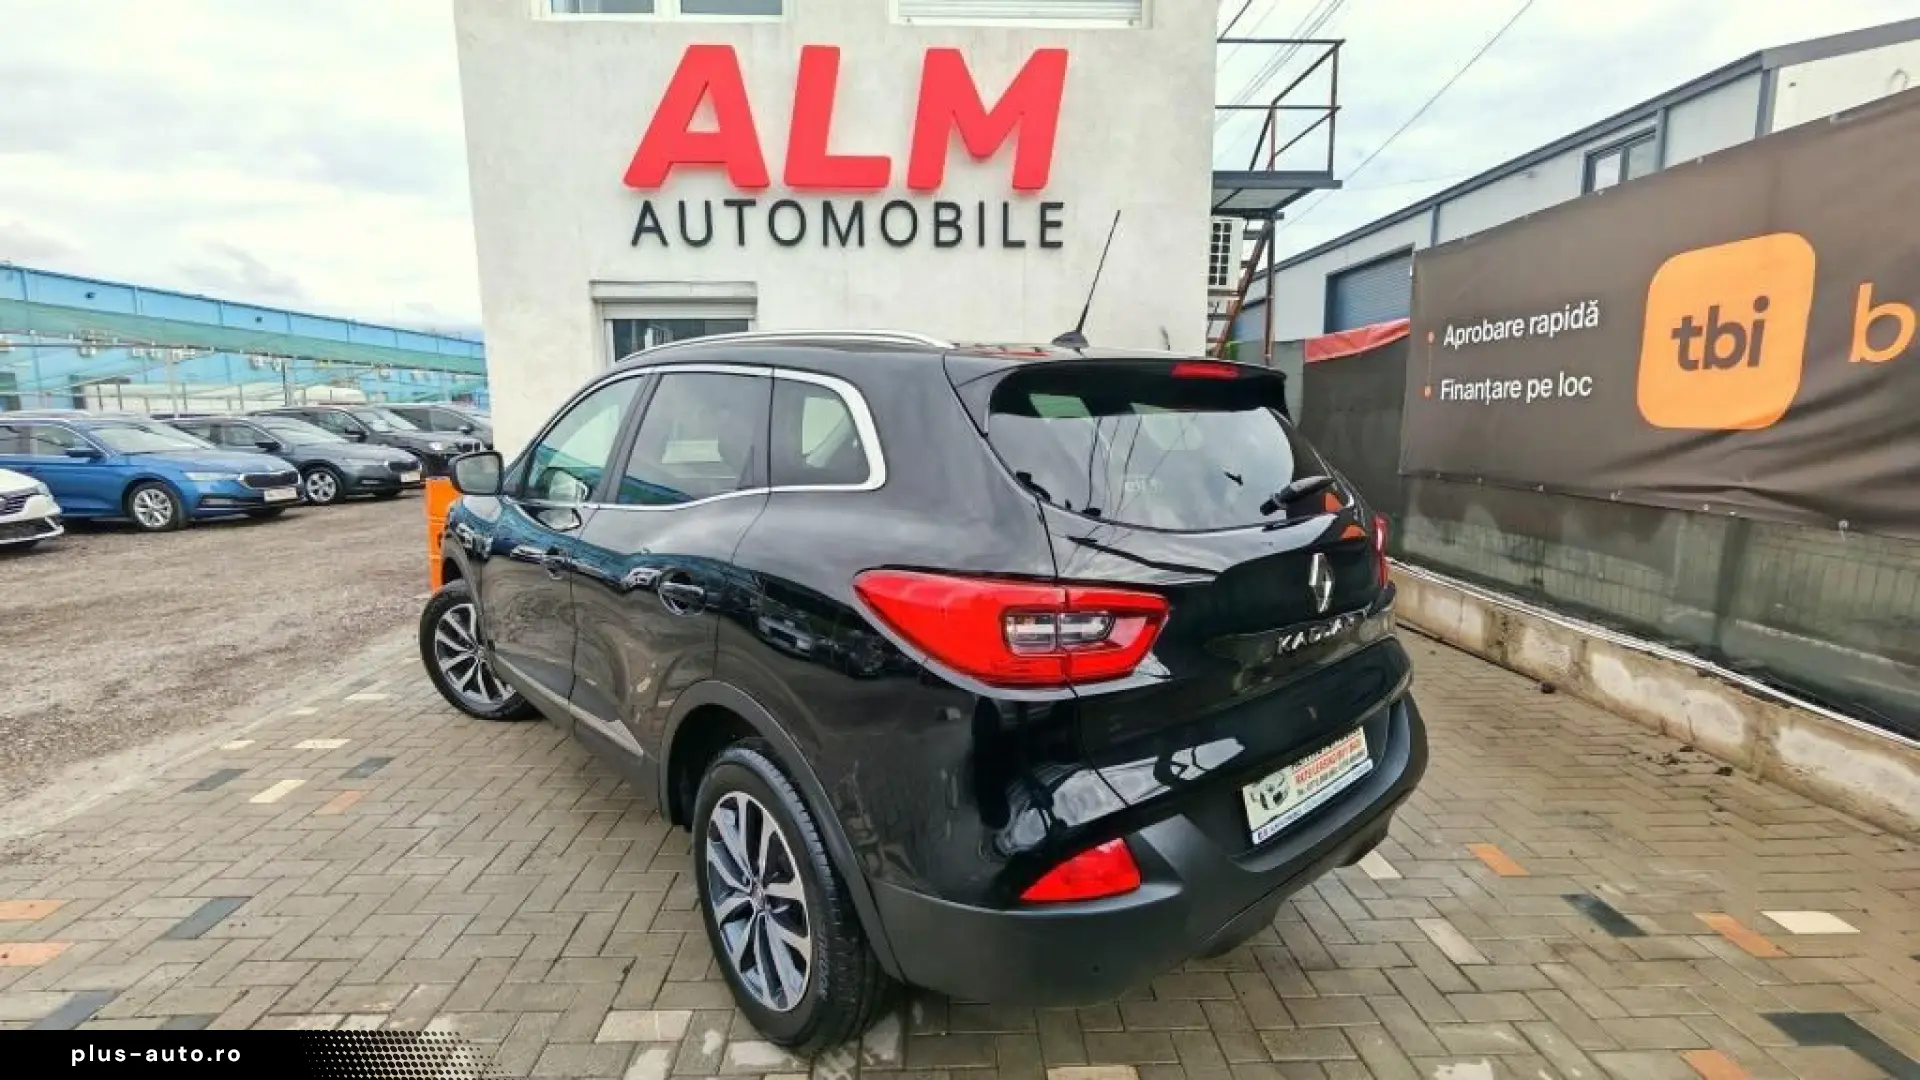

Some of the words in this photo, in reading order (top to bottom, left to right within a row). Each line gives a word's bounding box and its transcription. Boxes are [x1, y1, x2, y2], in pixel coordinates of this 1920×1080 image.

[622, 44, 1069, 190] ALM
[631, 199, 1065, 249] AUTOMOBILE
[1443, 316, 1525, 348] Aprobare
[1529, 300, 1600, 337] rapidă
[1671, 295, 1771, 372] tbi
[1440, 376, 1522, 405] Finanțare
[1526, 380, 1554, 403] pe
[1558, 371, 1593, 398] loc
